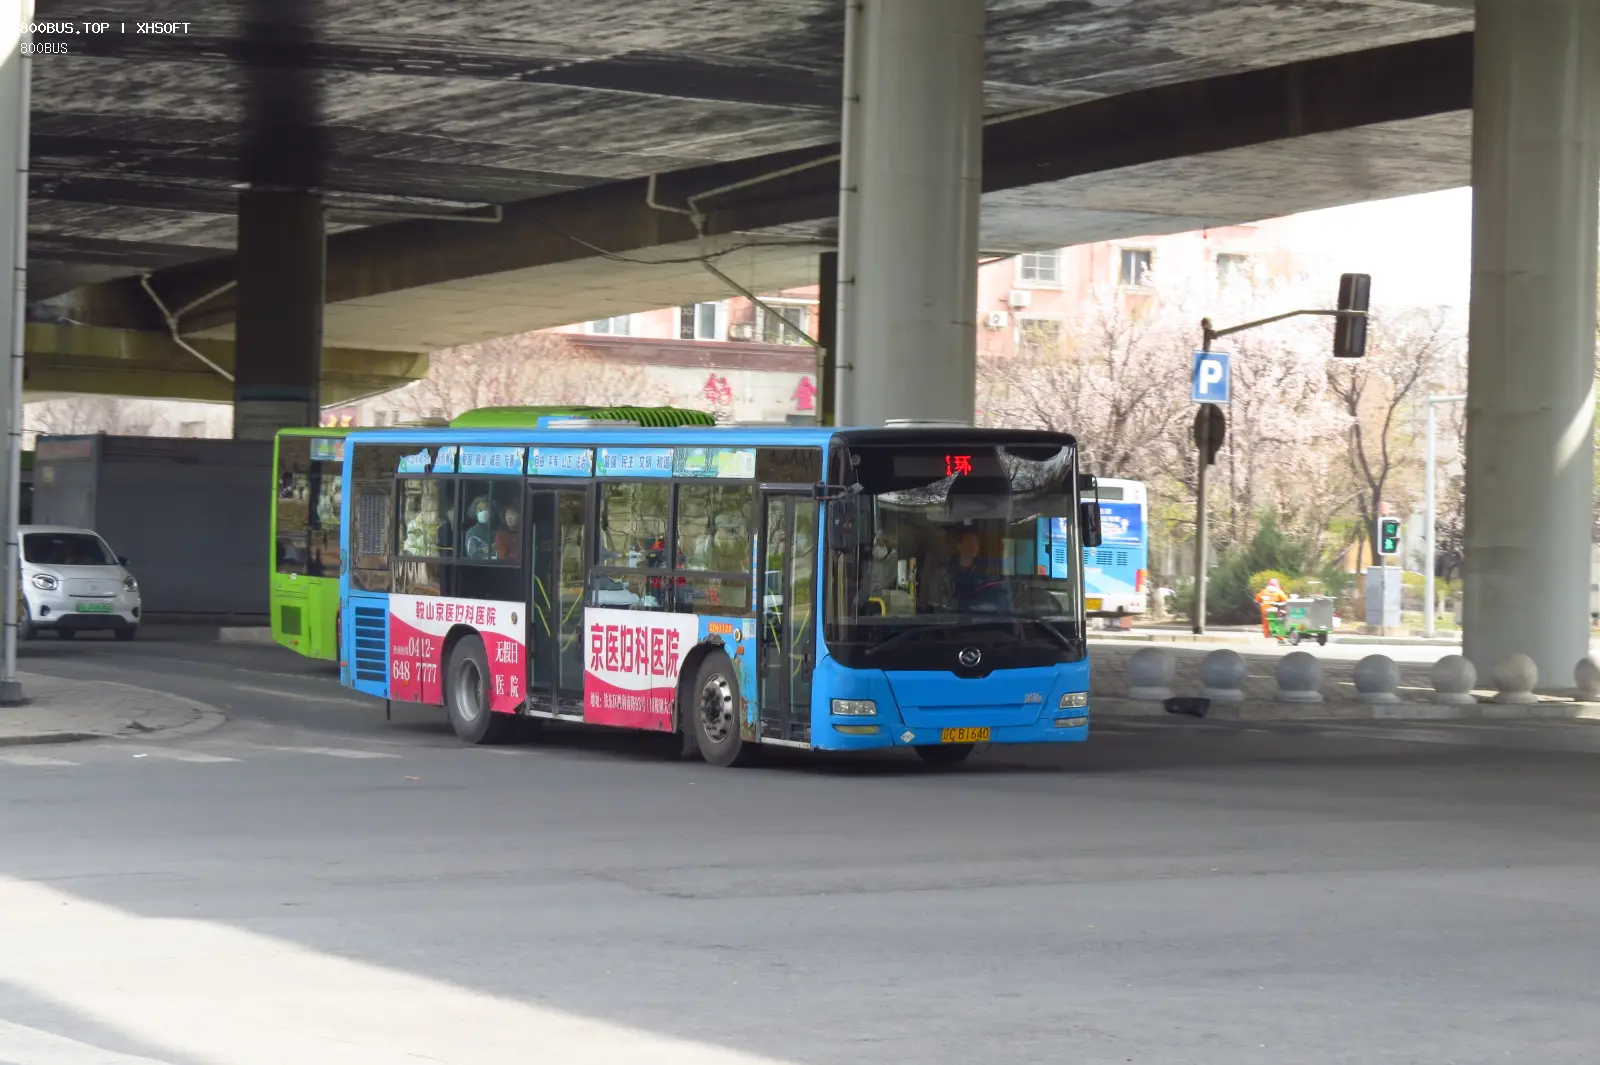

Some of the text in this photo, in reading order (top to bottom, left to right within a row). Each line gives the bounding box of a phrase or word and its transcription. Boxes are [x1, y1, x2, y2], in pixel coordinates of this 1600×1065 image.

[1199, 359, 1223, 394] P
[621, 456, 635, 469] 民主
[639, 456, 652, 469] 文明
[415, 601, 497, 626] 鞍山京医妇科医院
[408, 637, 434, 658] 0412-
[495, 640, 518, 664] 无假日
[590, 623, 680, 678] 京医妇科医院
[393, 660, 437, 684] 648 7777
